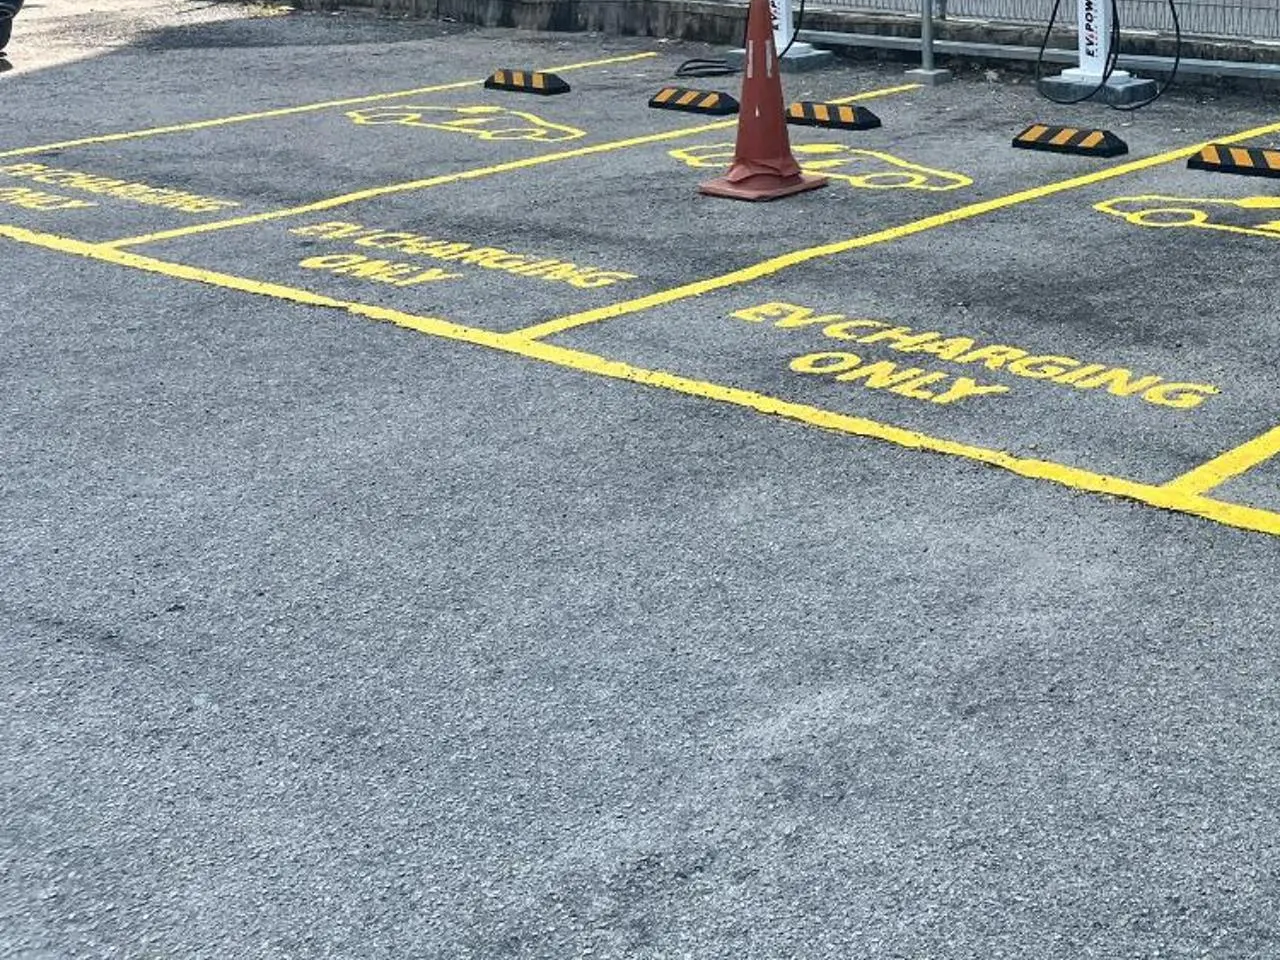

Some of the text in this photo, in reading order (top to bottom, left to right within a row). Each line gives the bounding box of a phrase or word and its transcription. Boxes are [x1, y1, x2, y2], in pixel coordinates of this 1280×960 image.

[288, 221, 639, 288] EV CHARGING
[299, 253, 464, 287] ONLY
[730, 301, 1222, 408] EV CHARGING
[788, 351, 1010, 404] ONLY
